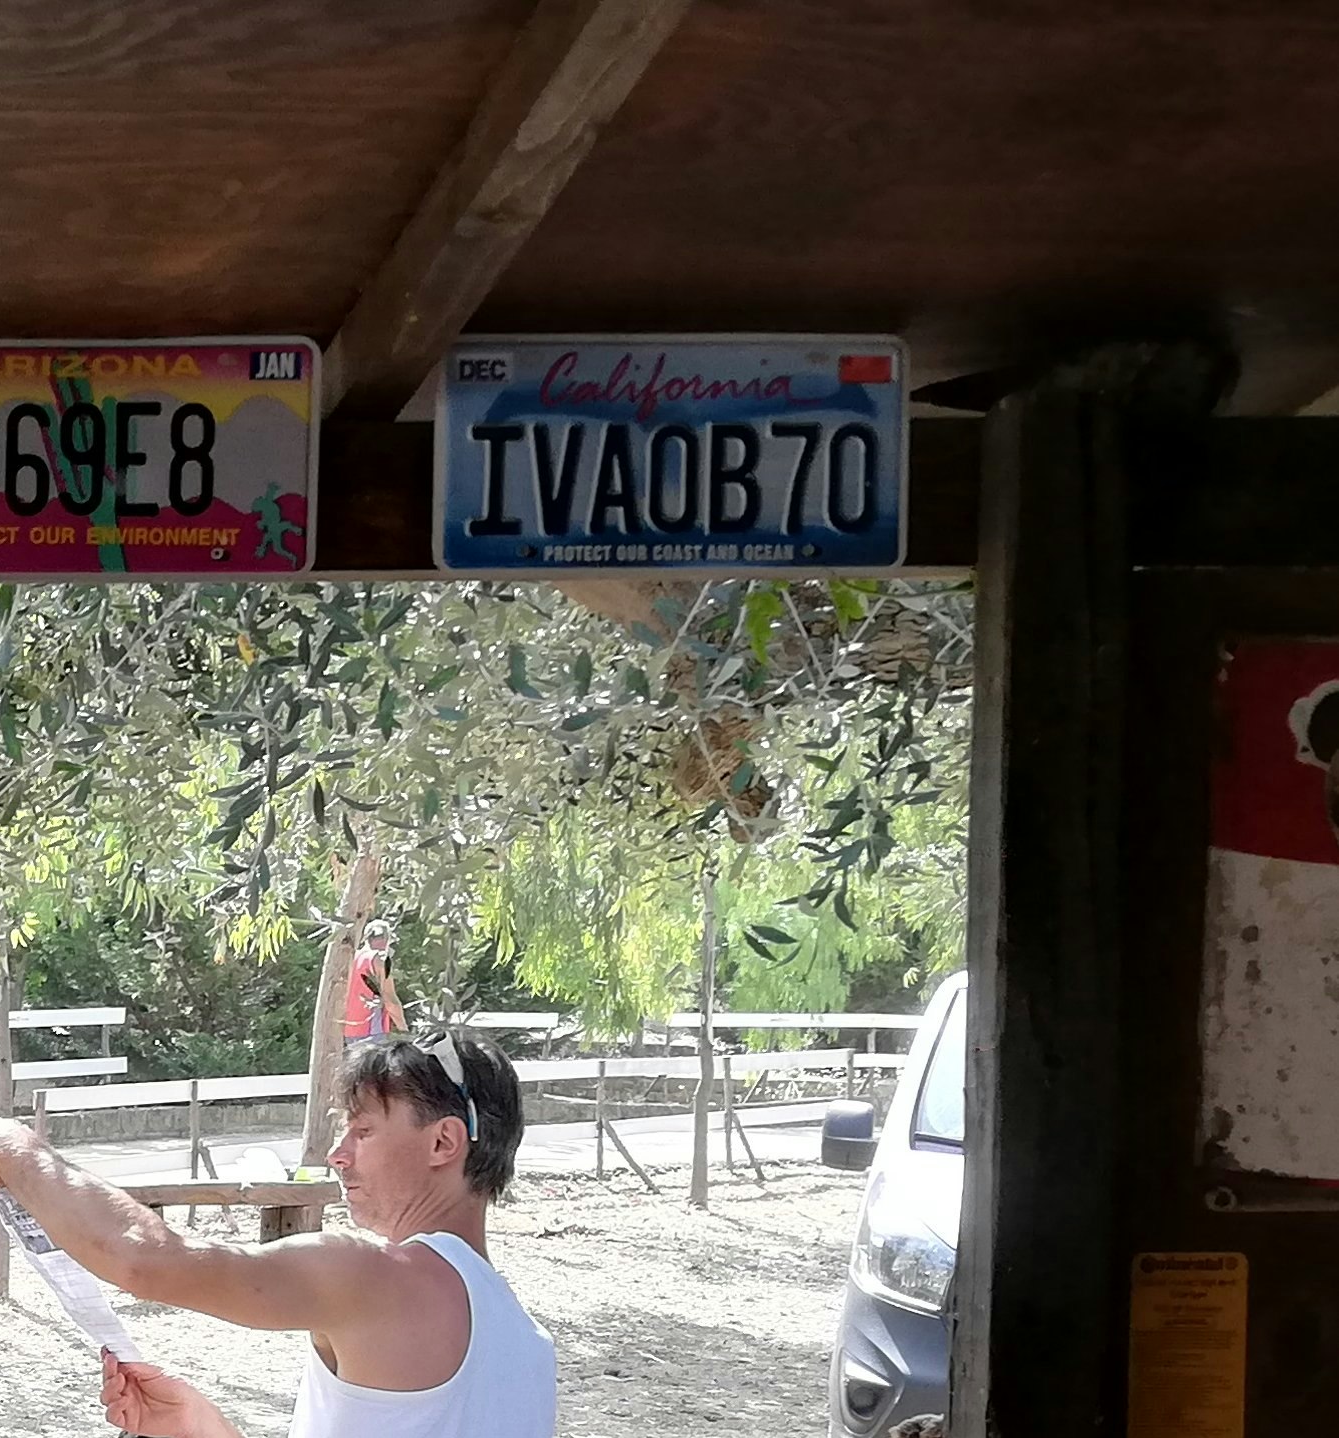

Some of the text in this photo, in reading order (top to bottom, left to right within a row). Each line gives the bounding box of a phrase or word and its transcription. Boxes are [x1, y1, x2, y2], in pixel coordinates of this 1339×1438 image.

[254, 352, 297, 380] JAN
[458, 358, 507, 382] DEC
[539, 351, 821, 424] California
[29, 526, 76, 546] OUR
[85, 526, 241, 547] ENVIRONMENT
[542, 543, 795, 562] PROTECT OUR COAST AND OCEAN
